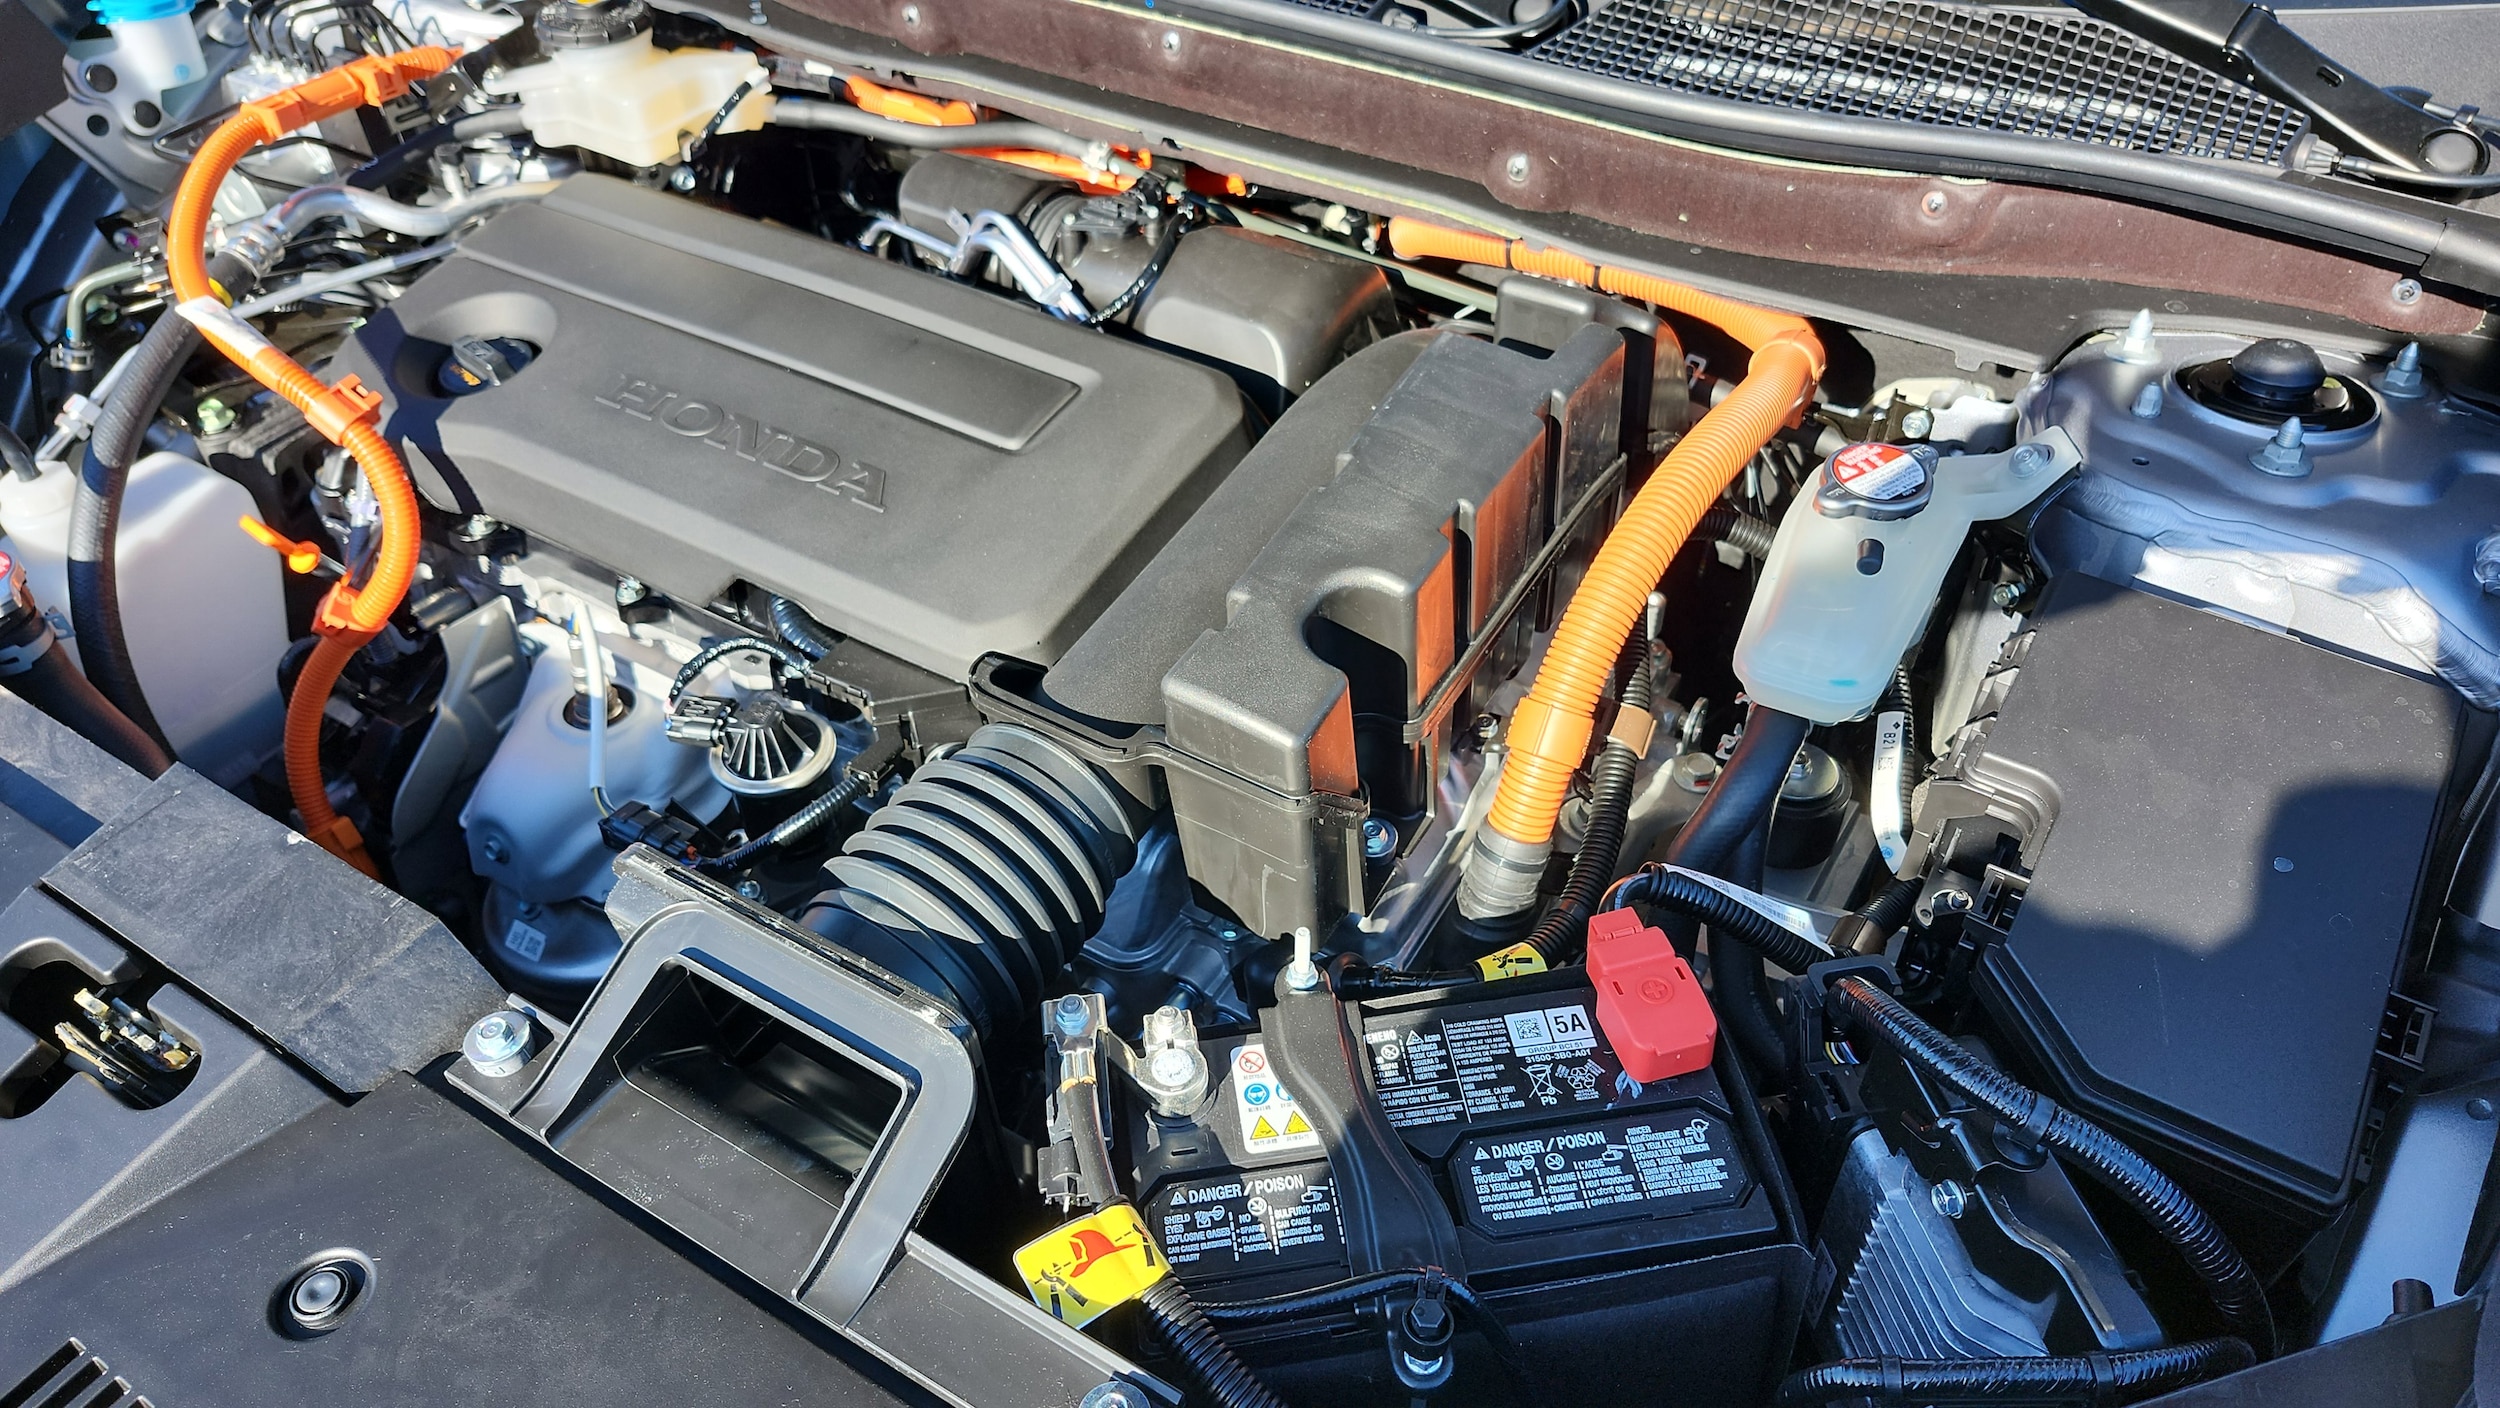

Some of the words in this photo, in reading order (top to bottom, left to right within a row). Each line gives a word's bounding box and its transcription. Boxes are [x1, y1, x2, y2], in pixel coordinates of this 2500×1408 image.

[595, 373, 886, 513] HONDA
[1553, 1013, 1587, 1034] 5A
[1528, 1044, 1557, 1054] GROUP
[1559, 1042, 1573, 1050] BCI
[1525, 1048, 1591, 1064] 31500-3B0-A01
[1408, 1096, 1421, 1105] CON
[1420, 1094, 1428, 1103] EL
[1499, 1094, 1510, 1102] LLC
[1540, 1095, 1558, 1106] Pb
[1491, 1140, 1545, 1159] DANGER
[1556, 1131, 1606, 1150] POISON
[1632, 1142, 1646, 1153] LES
[1645, 1141, 1661, 1150] YEUX
[1635, 1148, 1672, 1161] CONSULTER
[1471, 1165, 1482, 1175] SE
[1578, 1158, 1605, 1170] L'ACIDE
[1473, 1172, 1510, 1185] PROTÉGER
[1546, 1172, 1577, 1184] AUCUNE
[1581, 1165, 1622, 1180] SULFURIQUE
[1188, 1183, 1242, 1204] DANGER
[1255, 1174, 1305, 1195] POISON
[1475, 1184, 1490, 1194] LES
[1490, 1182, 1508, 1193] YEUX
[1508, 1181, 1519, 1190] LES
[1587, 1189, 1596, 1198] LA
[1550, 1192, 1576, 1203] FLAMME
[1274, 1206, 1311, 1219] SULFURIC
[1312, 1202, 1331, 1213] ACID
[1516, 1200, 1524, 1209] LA
[1553, 1200, 1585, 1213] CIGARETTE
[1163, 1213, 1190, 1225] SHIELD
[1238, 1213, 1251, 1224] NO
[1276, 1219, 1290, 1229] CAN
[1290, 1216, 1311, 1226] CAUSE
[1492, 1212, 1502, 1221] OU
[1165, 1223, 1184, 1235] EYES
[1313, 1224, 1323, 1232] OR
[1166, 1231, 1206, 1244] EXPLOSIVE
[1206, 1227, 1231, 1239] GASES
[1241, 1232, 1267, 1244] FLAMES
[1279, 1236, 1303, 1247] SEVERE
[1303, 1233, 1325, 1243] BURNS
[1167, 1245, 1180, 1254] CAN
[1168, 1256, 1178, 1264] OR
